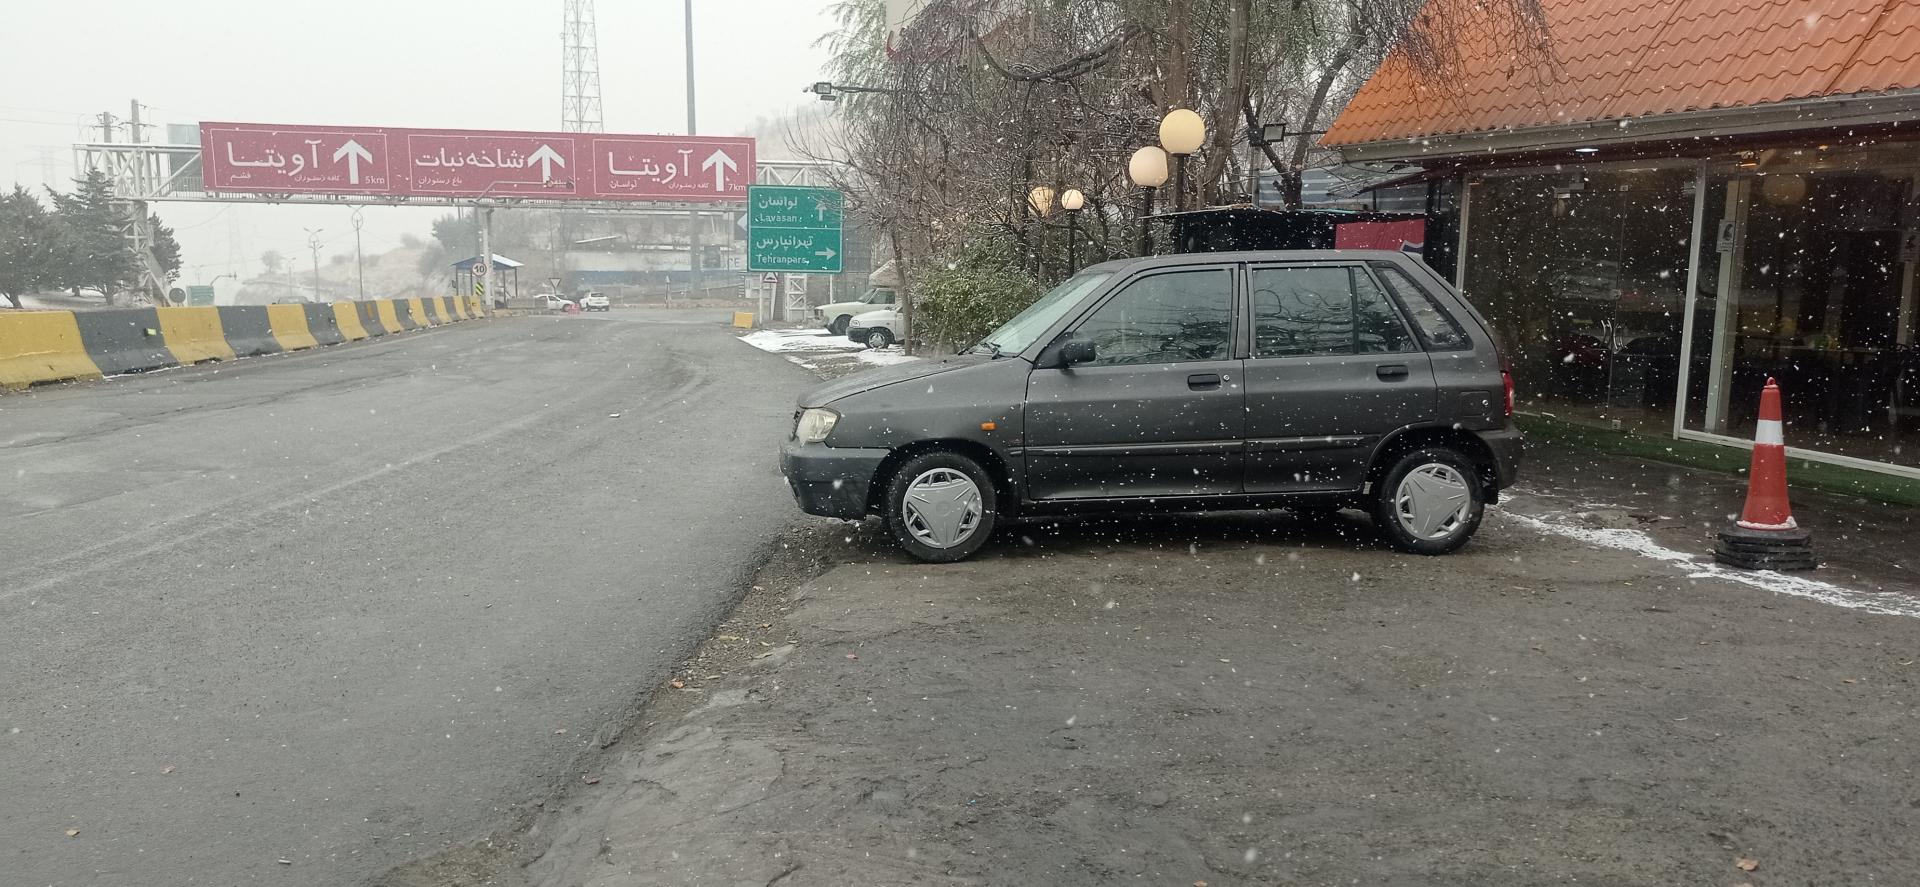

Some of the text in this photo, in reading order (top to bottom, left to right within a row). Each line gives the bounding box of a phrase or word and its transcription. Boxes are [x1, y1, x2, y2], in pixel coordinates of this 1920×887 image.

[227, 139, 322, 176] آویتا
[608, 149, 694, 184] آویتا
[758, 195, 798, 210] لواسان
[760, 213, 797, 222] Lavasan
[756, 235, 814, 252] تهرانپارس
[755, 253, 806, 265] Tehranpars
